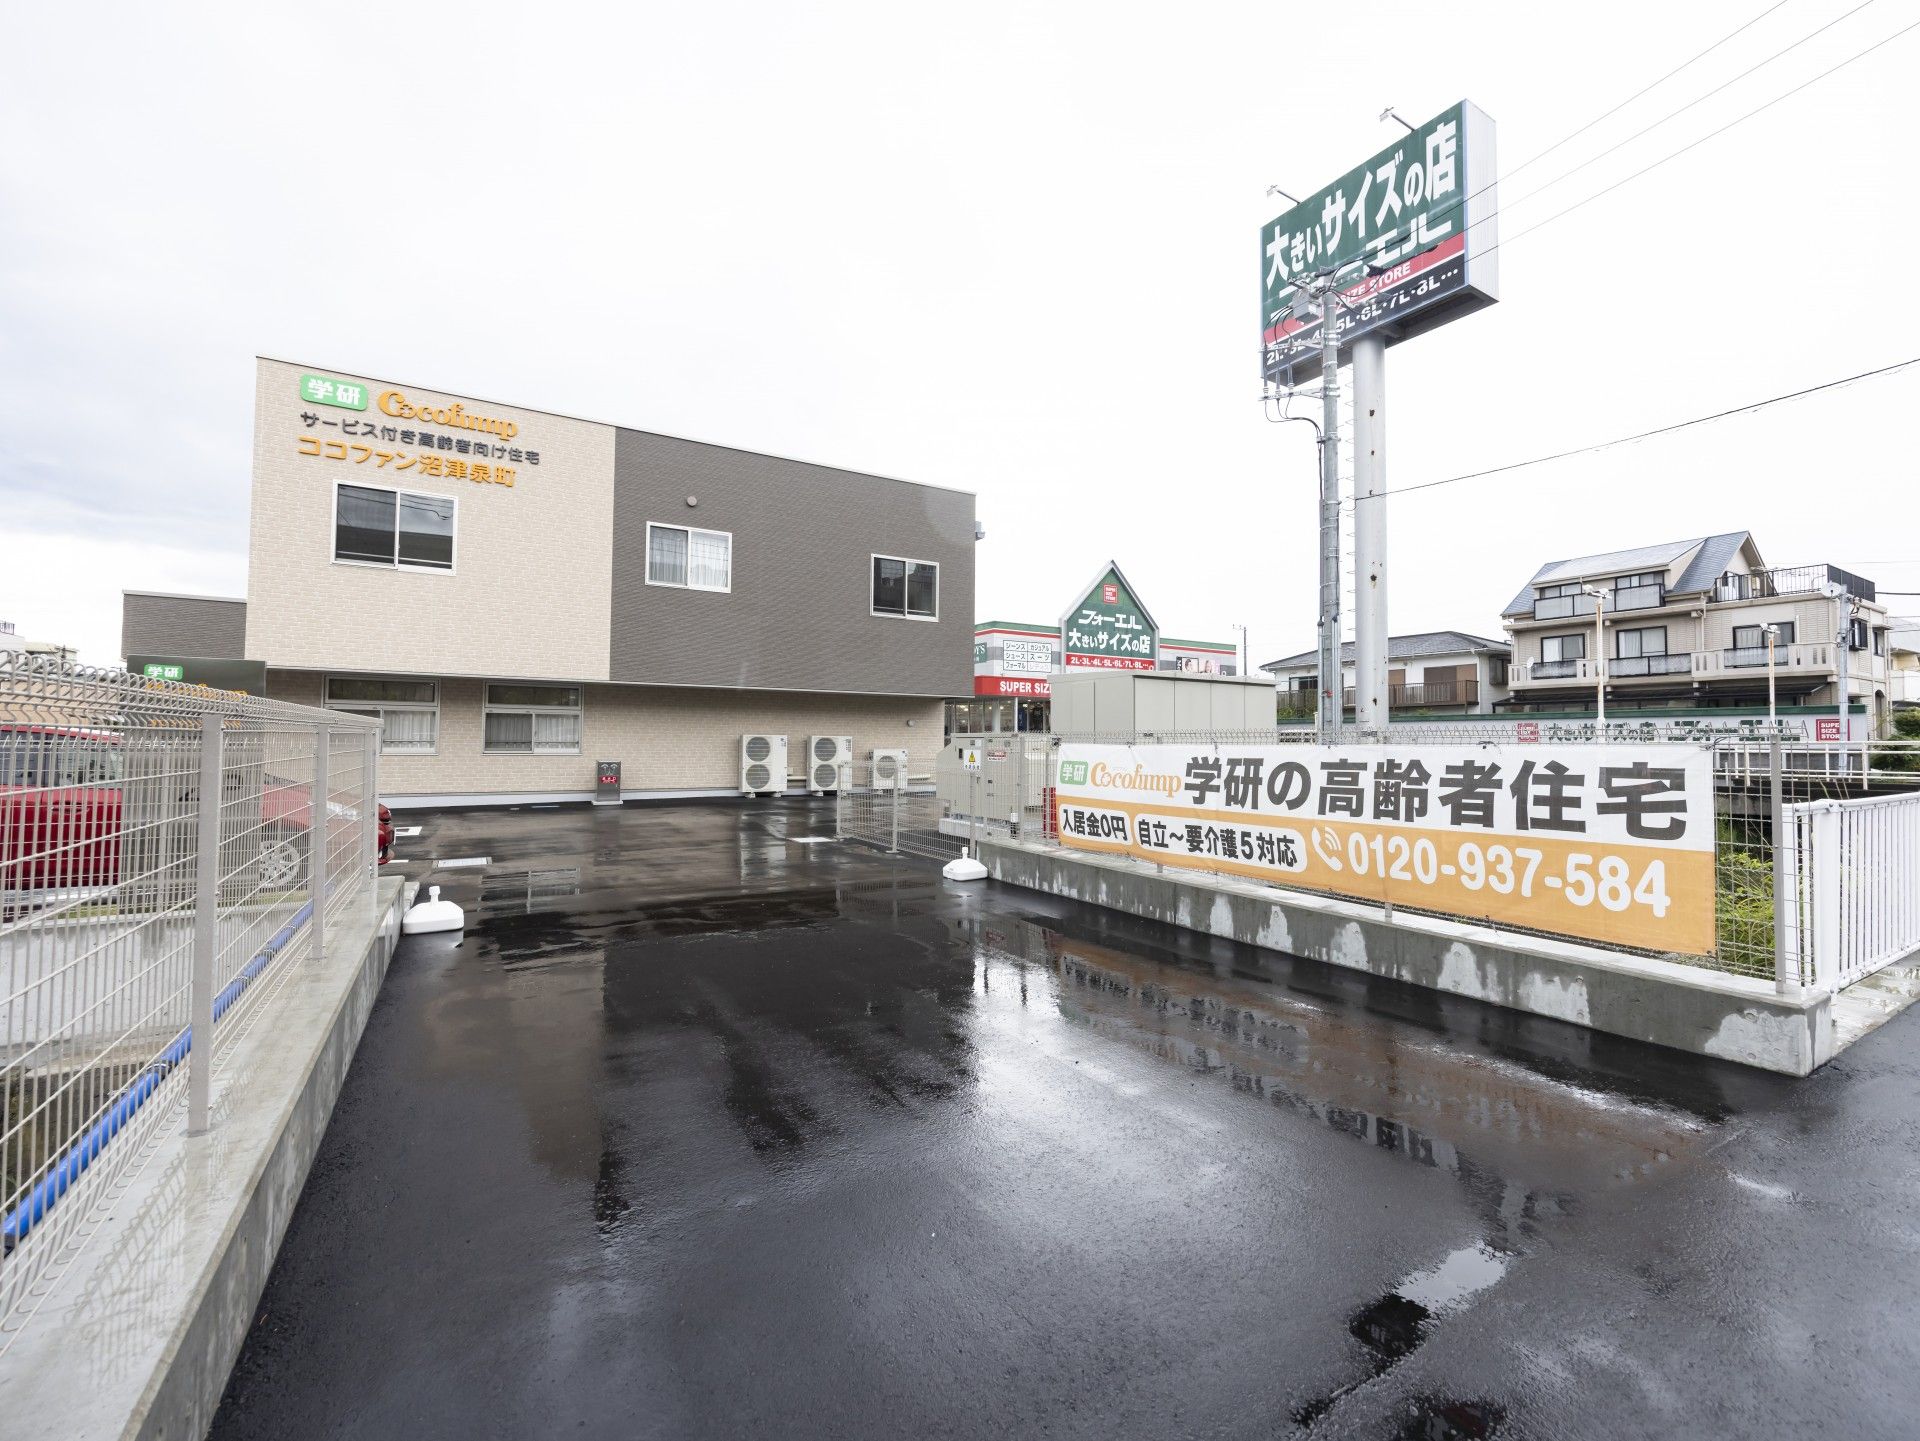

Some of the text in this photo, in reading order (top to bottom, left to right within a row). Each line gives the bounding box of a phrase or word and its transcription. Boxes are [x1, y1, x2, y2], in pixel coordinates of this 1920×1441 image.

[1265, 120, 1457, 290] 大きいサイズの店
[307, 377, 361, 407] 学研
[299, 411, 541, 466] サービス付き高齢者向け住宅
[298, 435, 518, 488] ココファン沼津泉町
[1078, 609, 1143, 630] フォーエル
[1068, 627, 1151, 654] 大きいサイズの店
[147, 666, 180, 678] 学研
[1000, 680, 1052, 694] SUPER SIZ
[1062, 761, 1086, 783] 学研
[1184, 756, 1688, 841] 学研の高齢者住宅
[1062, 808, 1129, 842] 入居金0円
[1348, 831, 1671, 918] 0120-937-584
